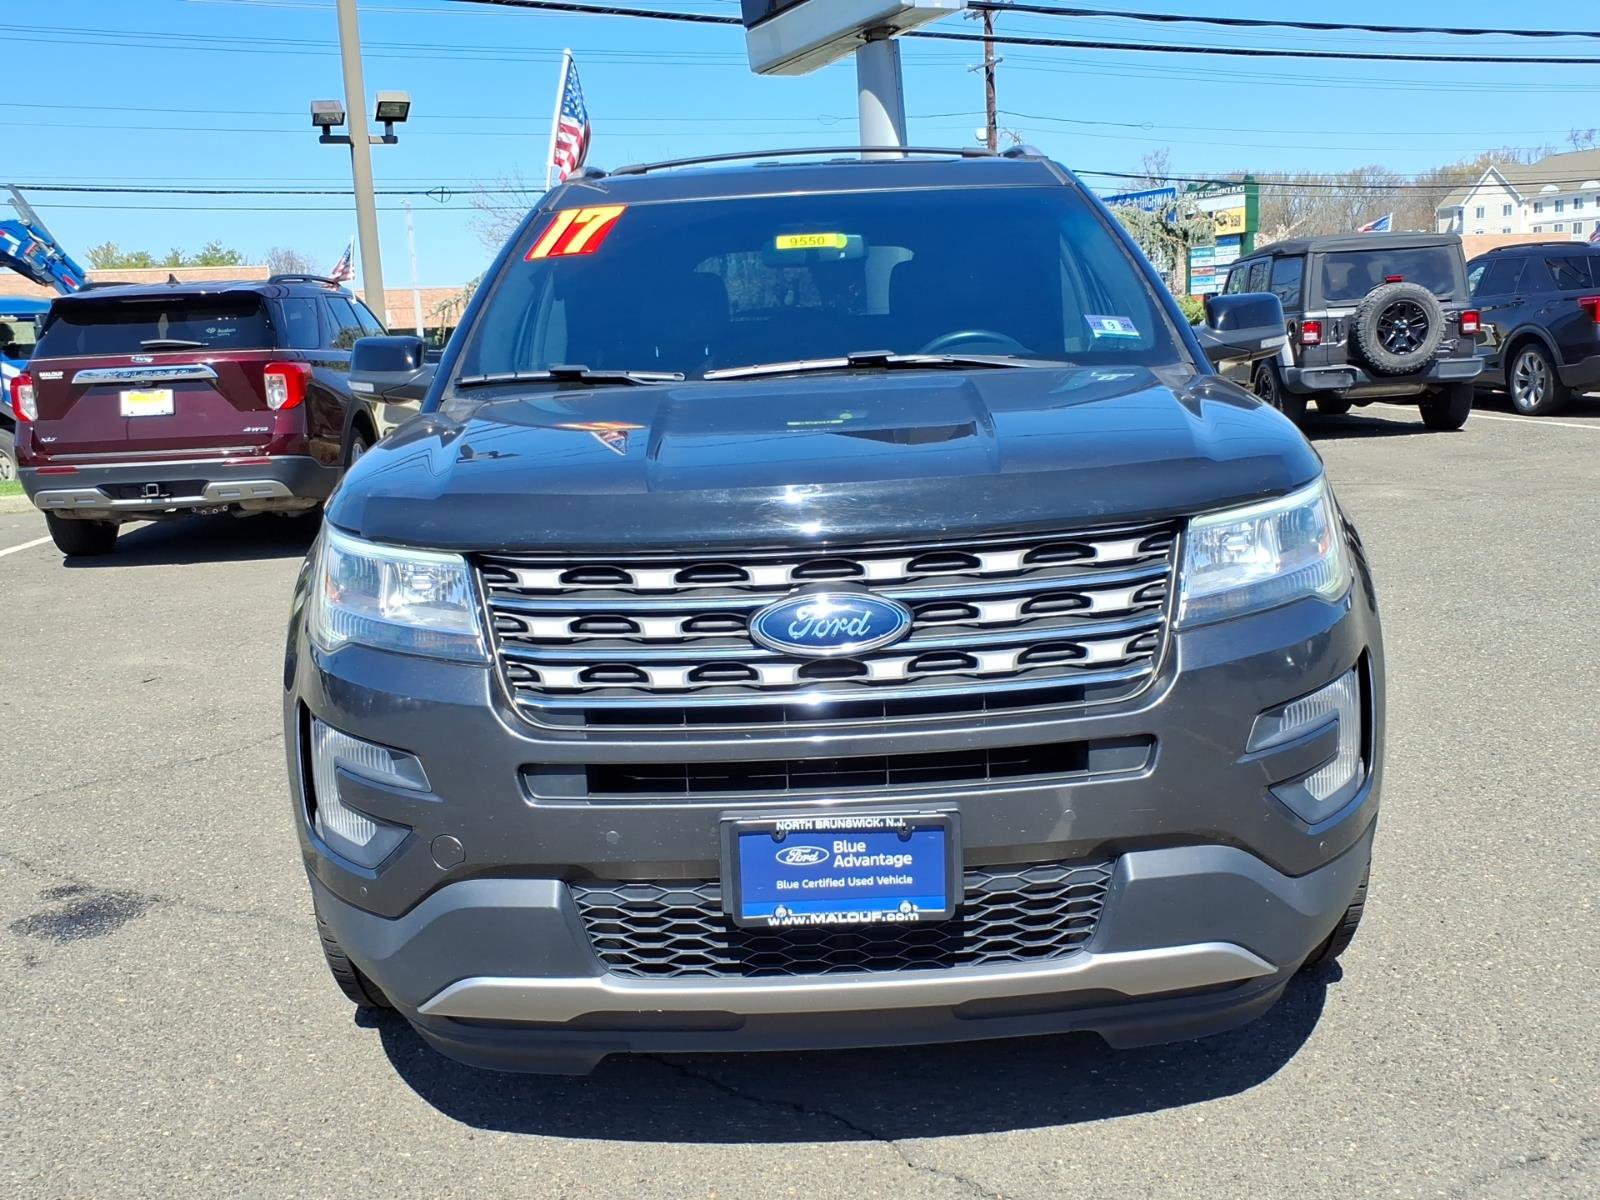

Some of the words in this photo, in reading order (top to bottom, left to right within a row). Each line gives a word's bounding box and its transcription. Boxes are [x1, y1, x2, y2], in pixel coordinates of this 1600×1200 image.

[530, 205, 626, 259] 17
[790, 236, 825, 247] 9550
[788, 604, 872, 639] Ford
[776, 819, 813, 831] NORTH
[886, 817, 906, 827] N.J.
[833, 840, 866, 853] Blue
[785, 847, 818, 862] Ford
[833, 853, 912, 868] Advantage
[776, 879, 800, 889] Blue
[802, 878, 846, 888] Certified
[847, 877, 874, 886] Used
[876, 875, 913, 885] Vehicle
[768, 910, 919, 926] www.MALOUF.com
